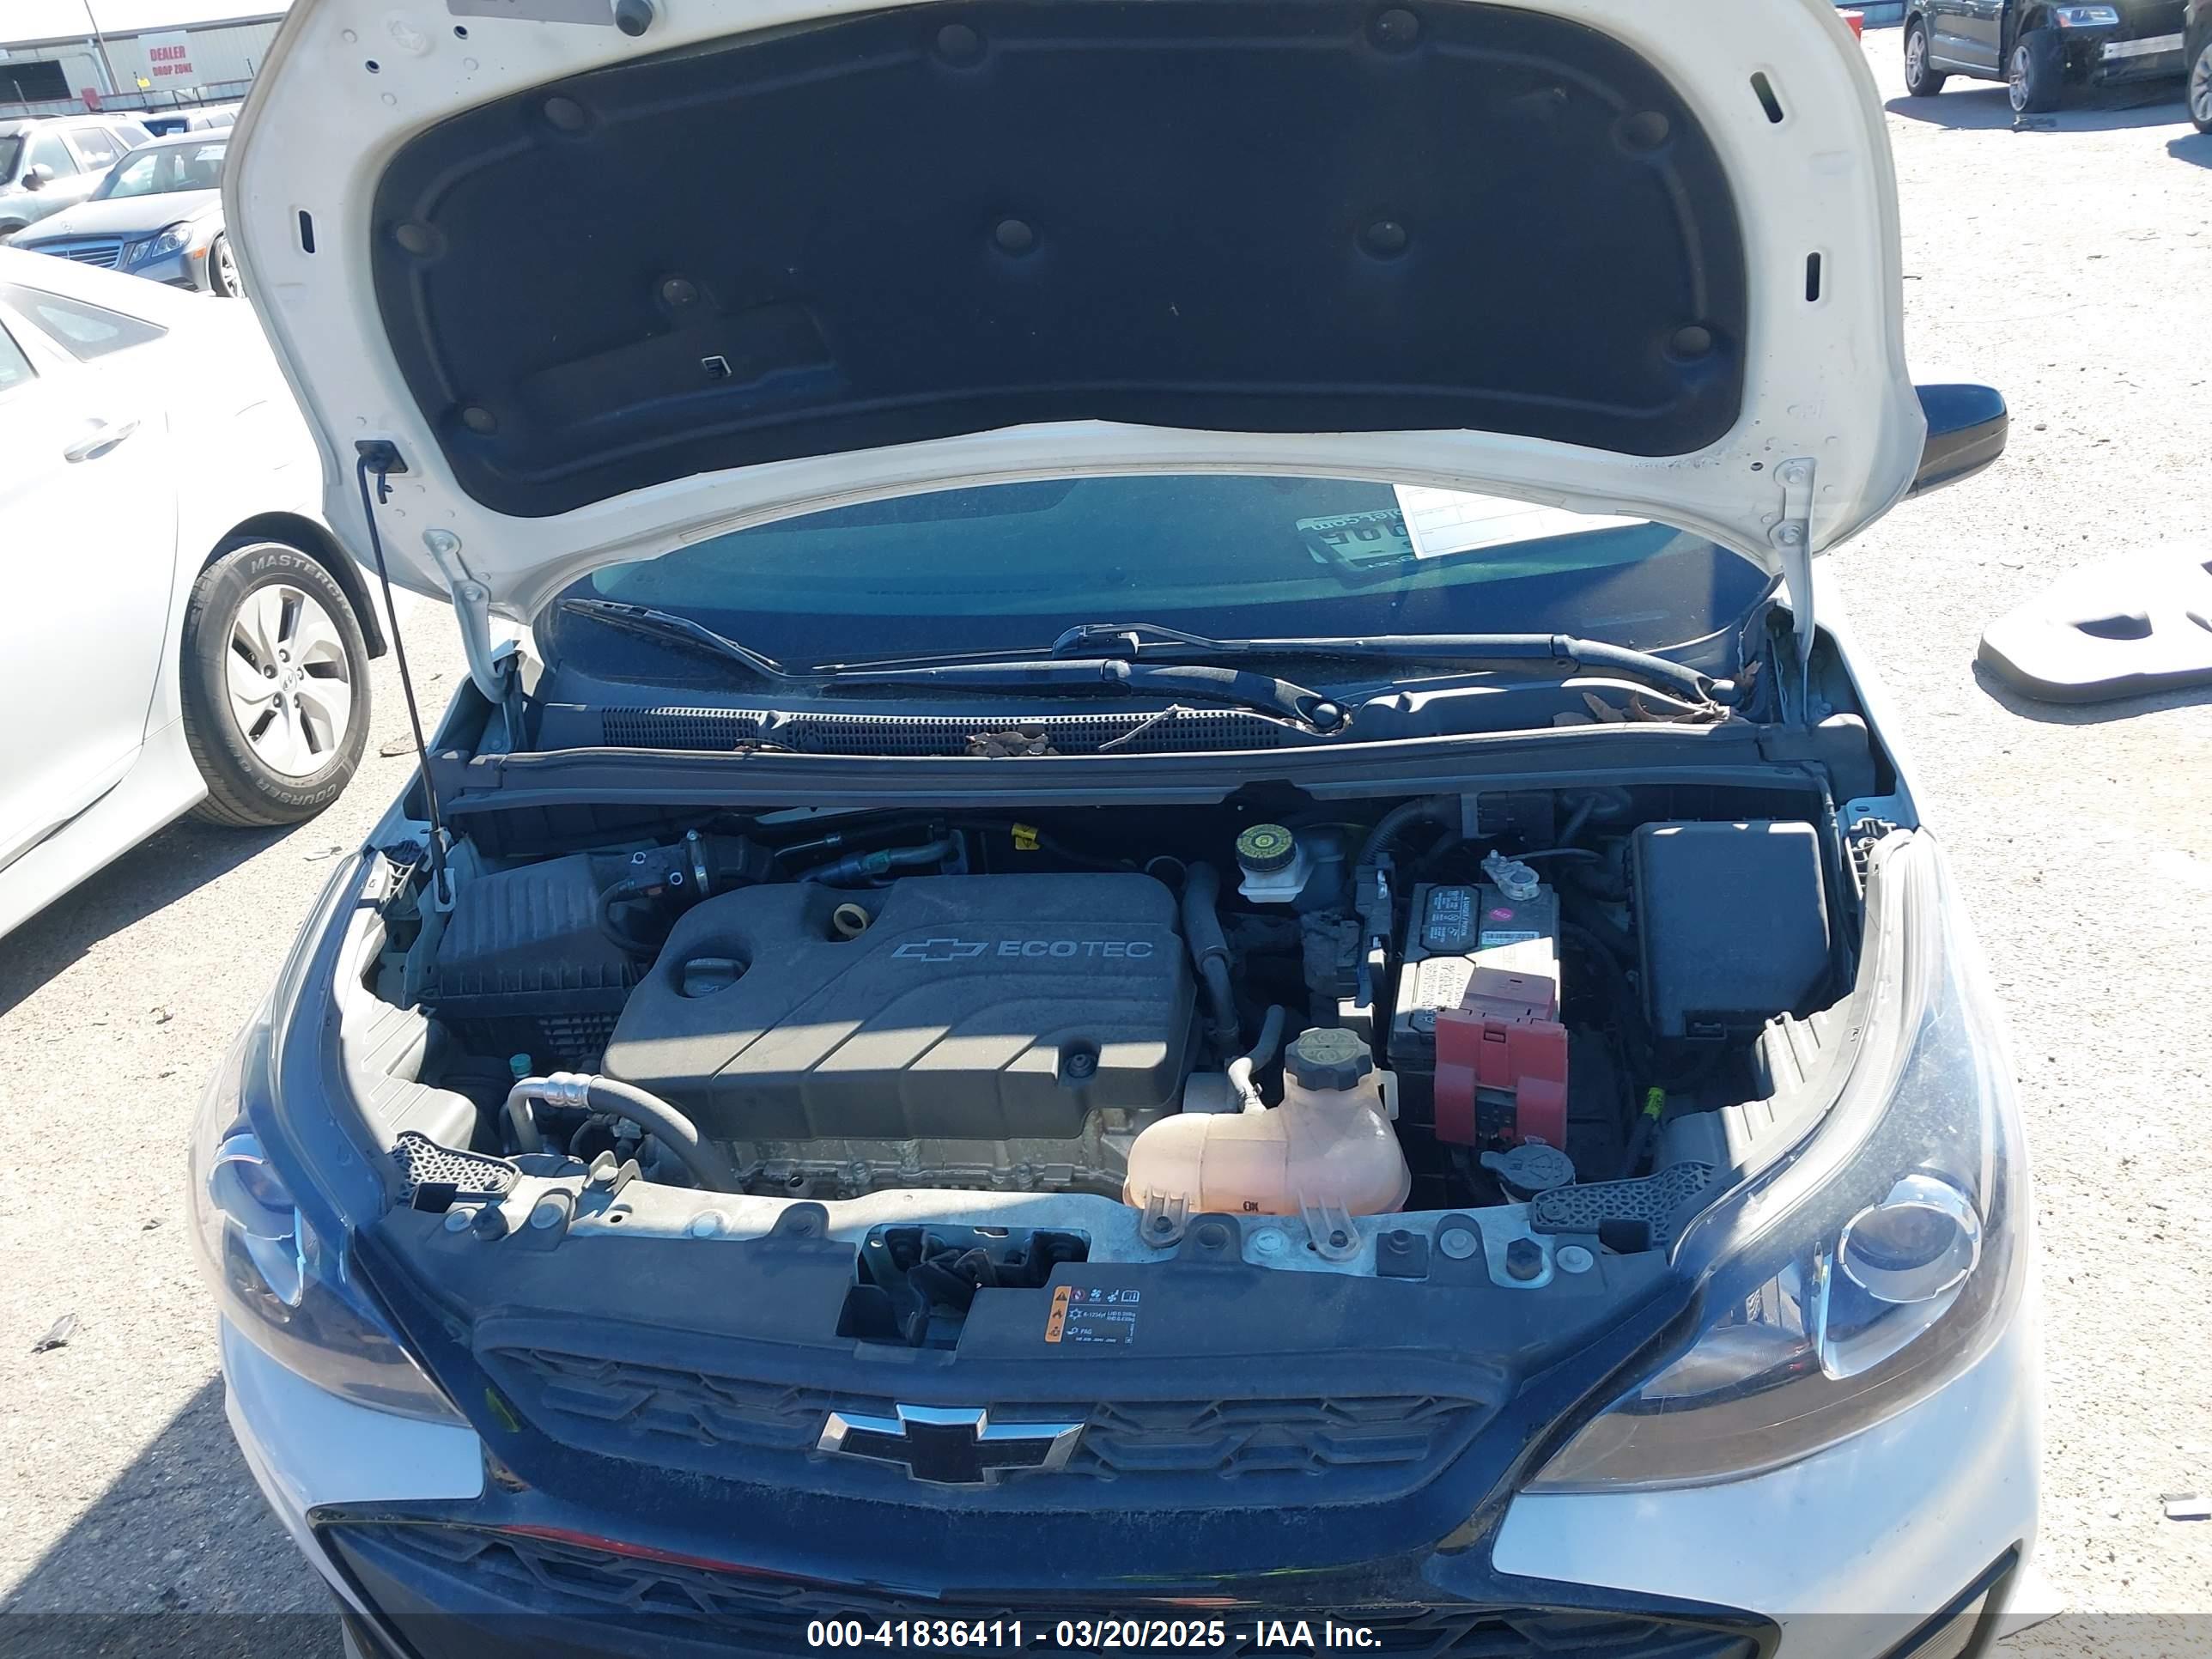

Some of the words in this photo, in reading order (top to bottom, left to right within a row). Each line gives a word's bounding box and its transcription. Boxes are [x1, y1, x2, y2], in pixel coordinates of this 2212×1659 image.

[150, 46, 185, 62] DEALER
[153, 65, 173, 76] DROP
[174, 63, 192, 74] ZONE
[255, 777, 337, 805] COURSER
[997, 940, 1153, 957] ECOTEC
